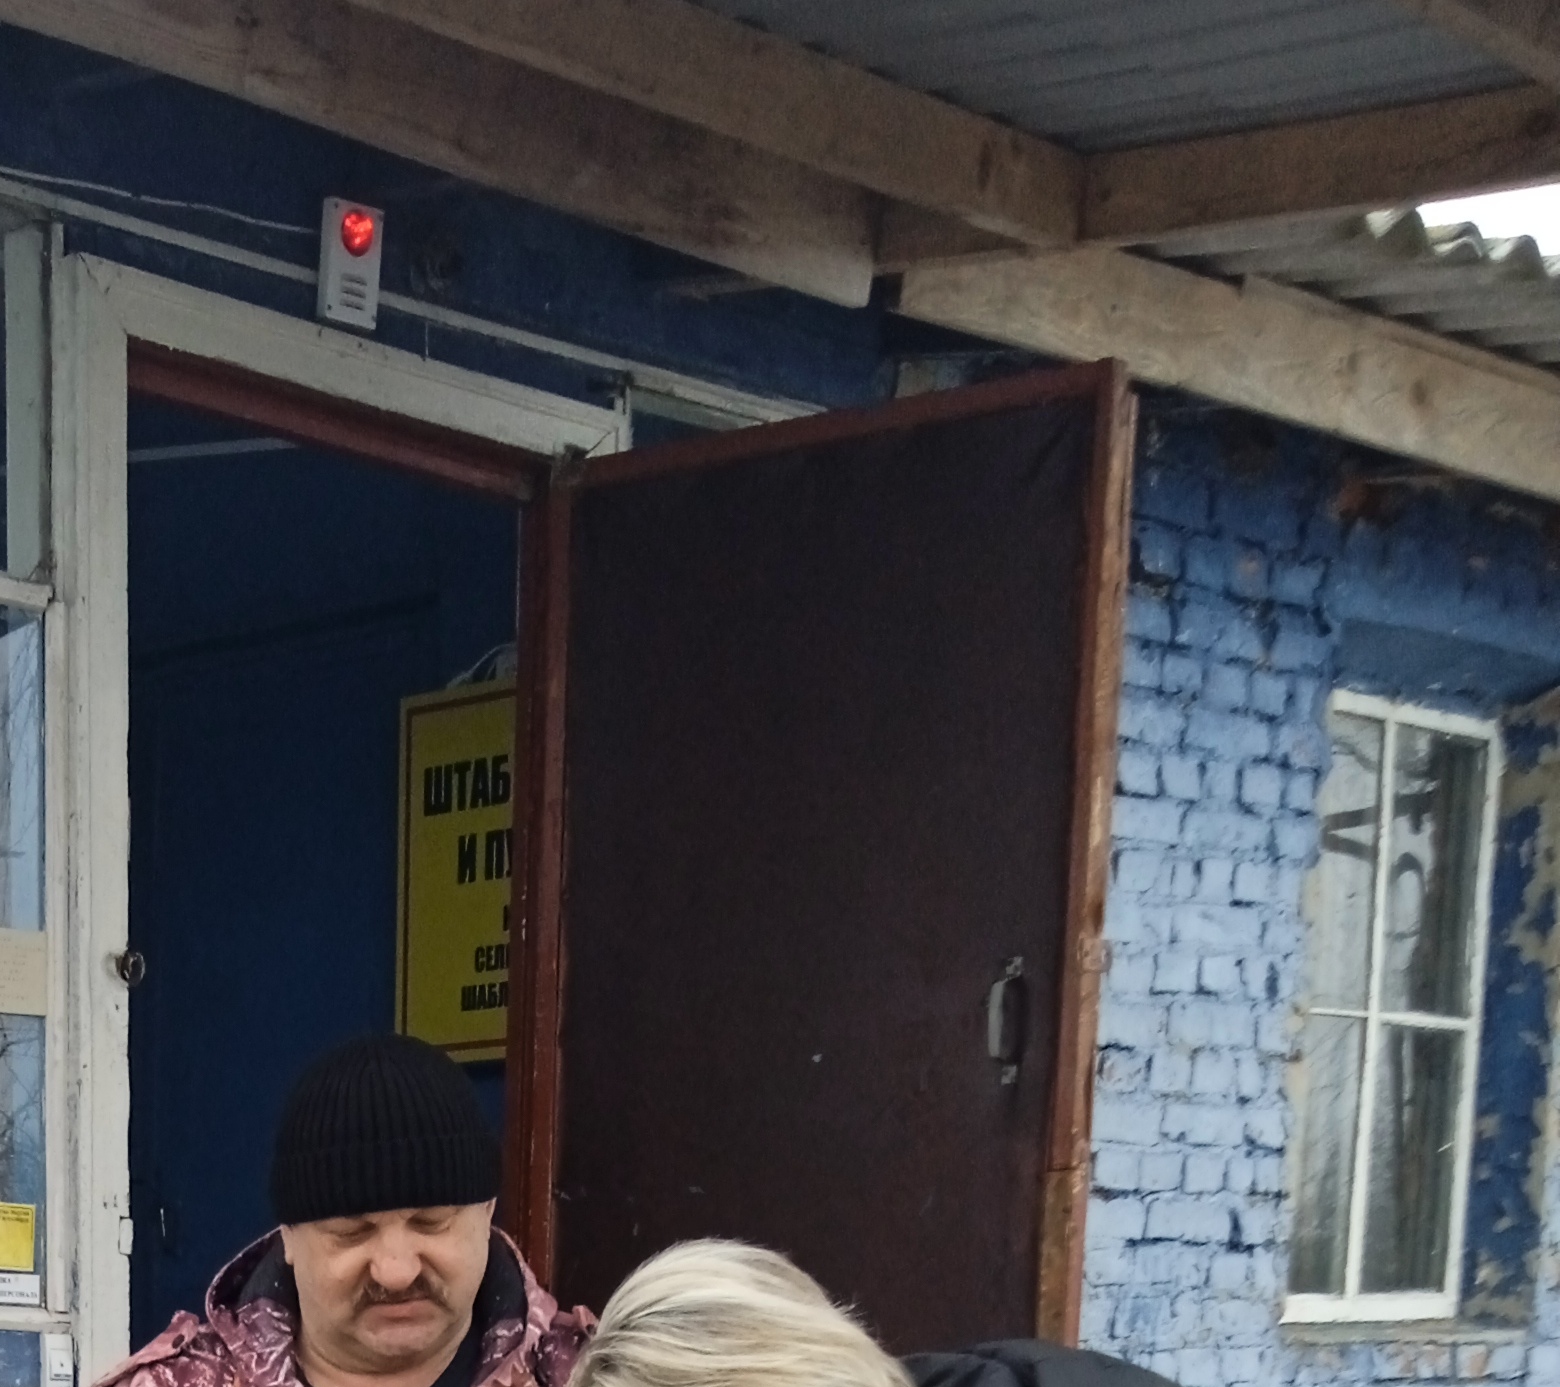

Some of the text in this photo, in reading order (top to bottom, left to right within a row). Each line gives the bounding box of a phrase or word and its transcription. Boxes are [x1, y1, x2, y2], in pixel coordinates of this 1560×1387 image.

[423, 754, 511, 817] ШТАБ
[457, 832, 478, 885] И
[474, 943, 510, 973] СЕЛ
